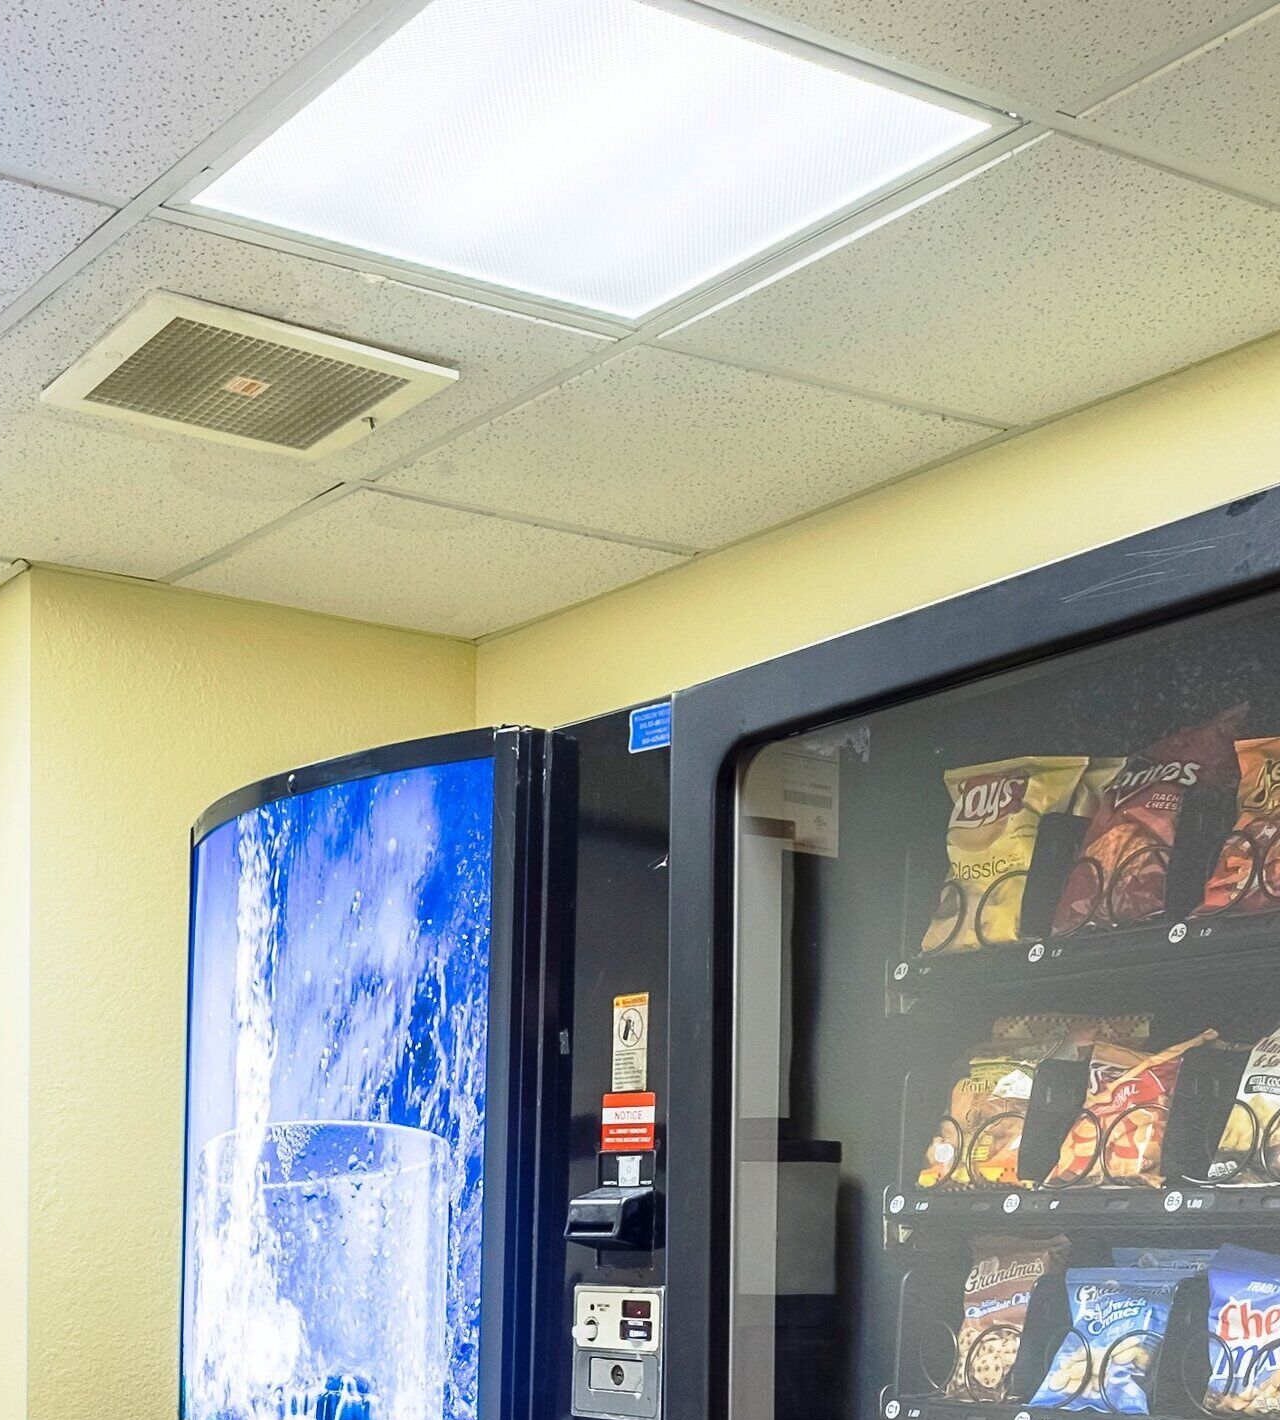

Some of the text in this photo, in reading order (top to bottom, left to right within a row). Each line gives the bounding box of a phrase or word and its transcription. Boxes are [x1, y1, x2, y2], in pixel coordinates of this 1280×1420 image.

[1170, 927, 1185, 940] A5
[614, 1110, 642, 1120] NOTICE
[965, 1258, 1044, 1294] Grandma's
